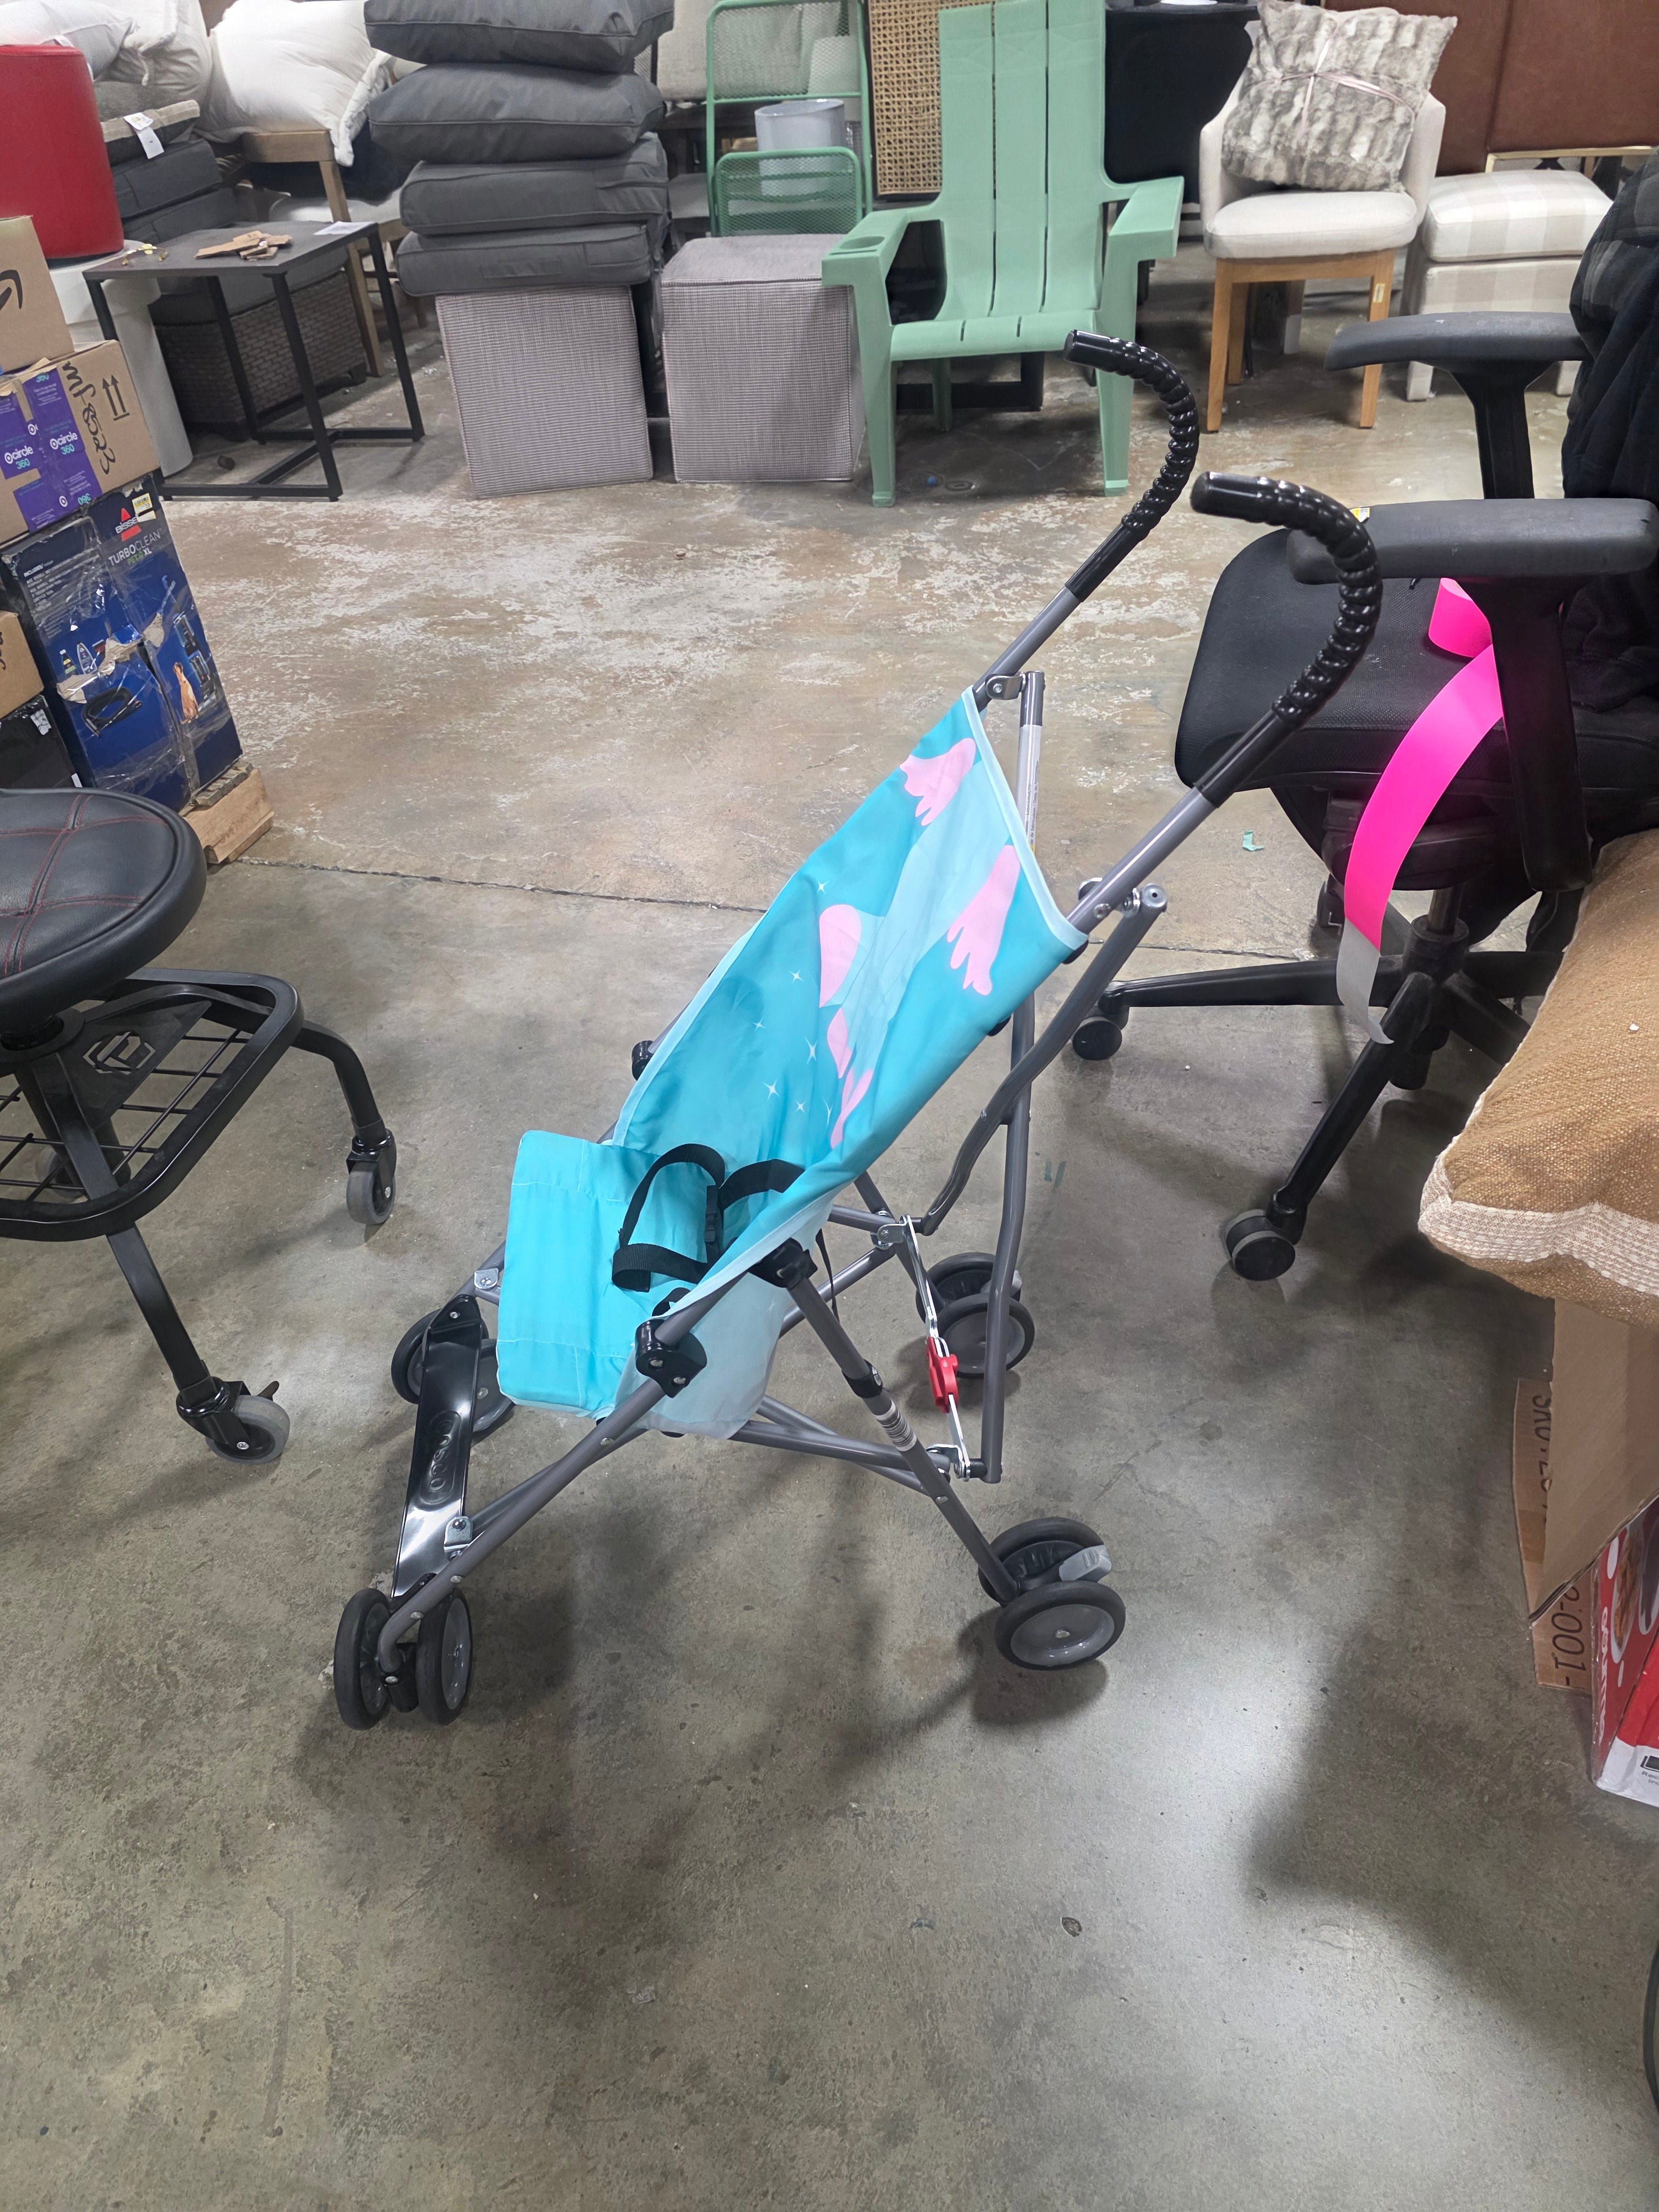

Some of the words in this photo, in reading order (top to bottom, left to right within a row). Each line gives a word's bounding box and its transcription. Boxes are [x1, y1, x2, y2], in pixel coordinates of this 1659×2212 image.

[56, 431, 78, 446] circle
[12, 445, 34, 460] circle
[61, 444, 75, 455] 360
[15, 458, 30, 469] 360
[108, 530, 161, 566] TURBOCLEAN
[143, 547, 152, 556] XL
